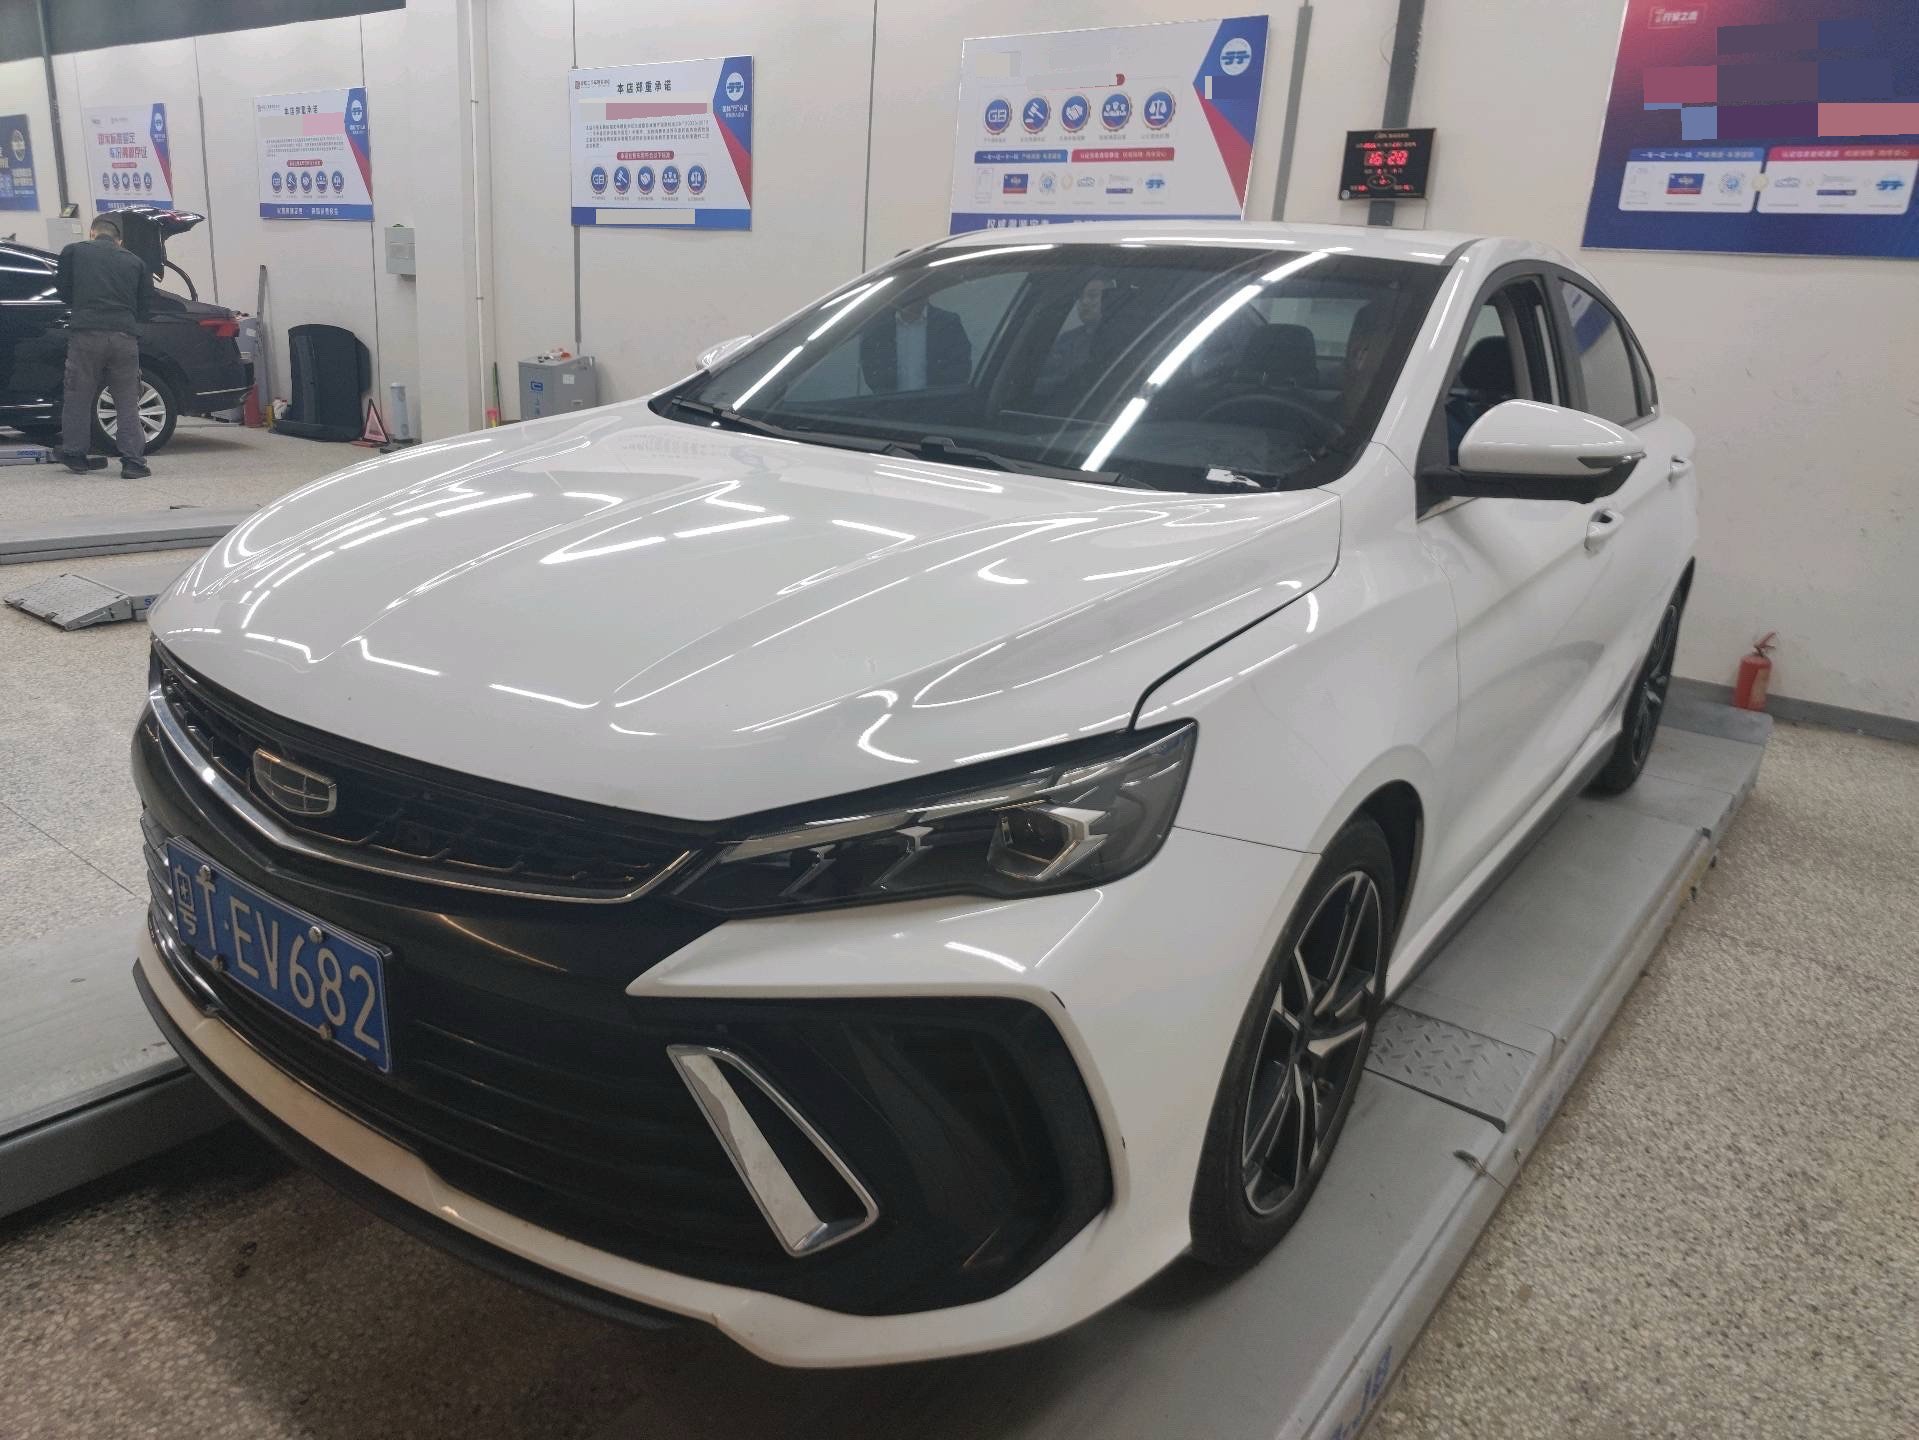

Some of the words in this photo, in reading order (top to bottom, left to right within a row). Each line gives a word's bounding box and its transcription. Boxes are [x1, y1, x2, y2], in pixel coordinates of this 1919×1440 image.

[617, 80, 672, 95] 本店郑重承诺
